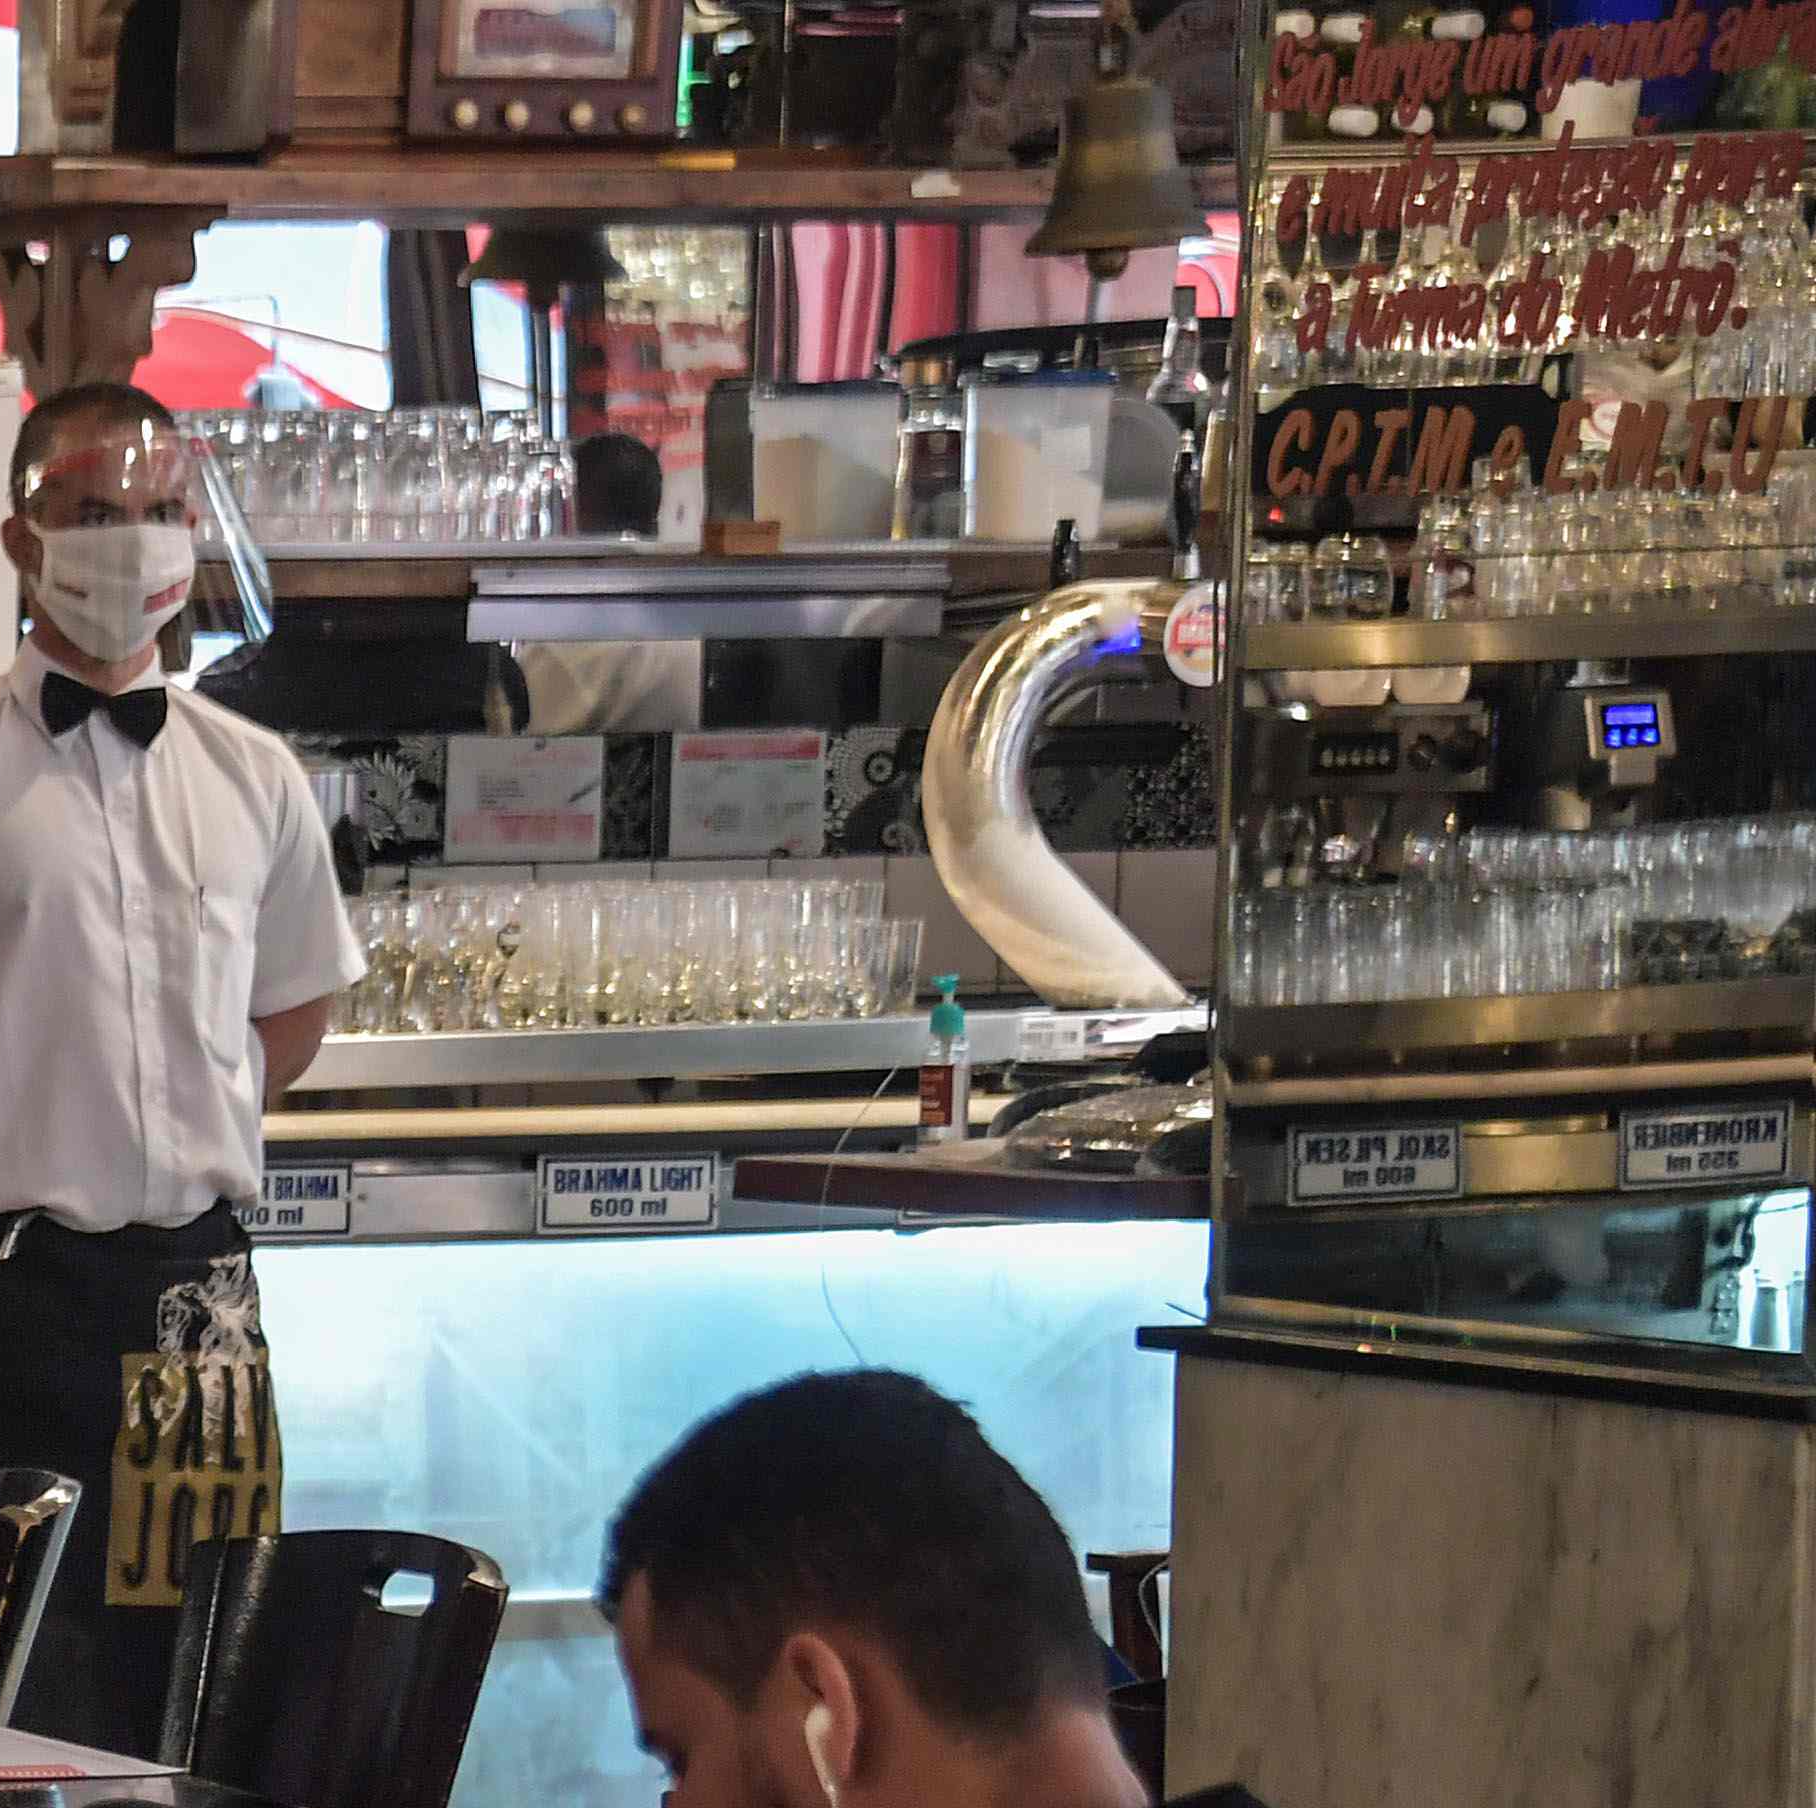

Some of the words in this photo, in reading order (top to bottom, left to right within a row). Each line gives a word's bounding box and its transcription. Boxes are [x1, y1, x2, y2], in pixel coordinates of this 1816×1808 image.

[1463, 31, 1537, 97] um
[1535, 0, 1707, 113] grande
[1275, 174, 1311, 242] e
[1311, 132, 1460, 237] muita
[1670, 130, 1806, 240] para
[1297, 282, 1333, 352] a
[1344, 263, 1487, 353] Turma
[1497, 254, 1563, 347] do
[1490, 424, 1526, 498] e
[274, 1174, 340, 1202] BRAHMA
[553, 1167, 643, 1194] BRAHMA
[649, 1166, 704, 1193] LIGHT
[239, 1206, 270, 1226] 00
[277, 1205, 304, 1226] ml
[590, 1198, 634, 1218] 600
[640, 1197, 667, 1217] ml
